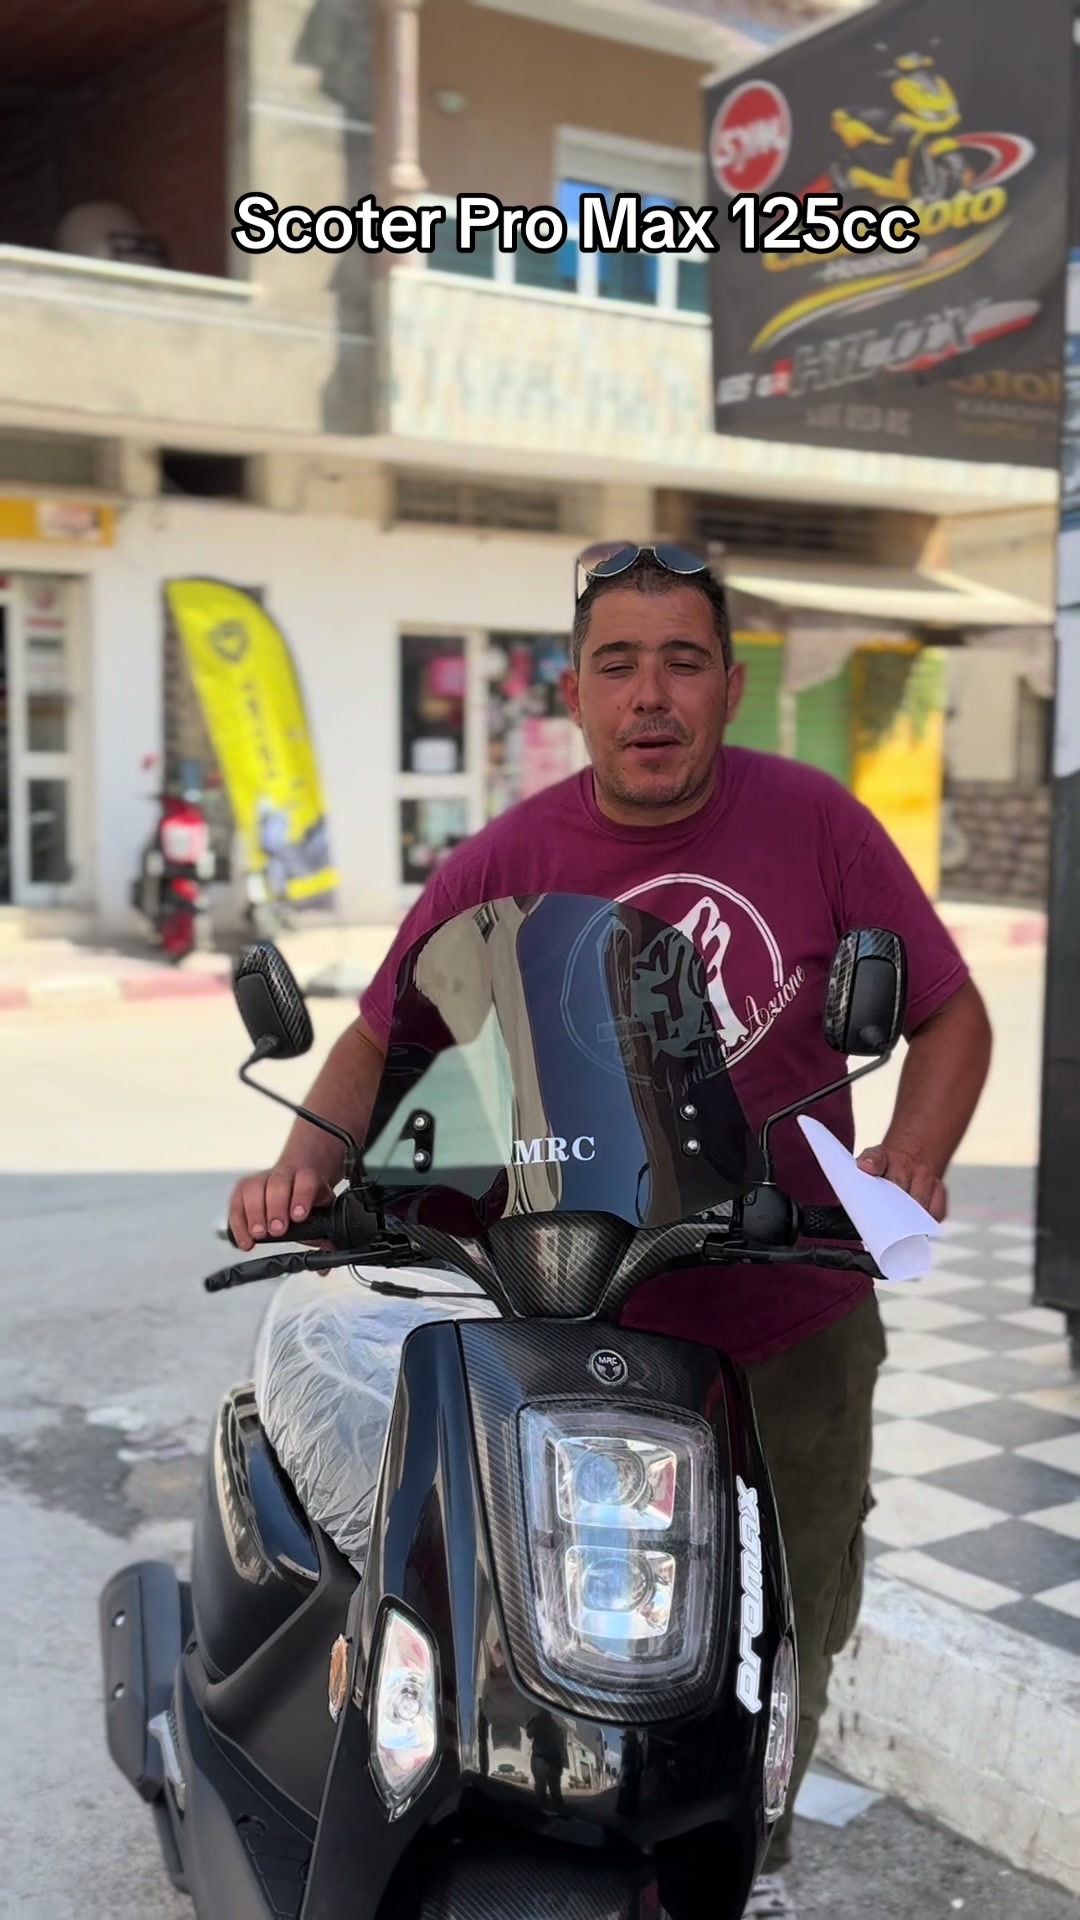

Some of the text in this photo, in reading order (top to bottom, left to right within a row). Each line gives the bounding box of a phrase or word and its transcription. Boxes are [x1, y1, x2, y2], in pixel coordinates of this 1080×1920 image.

[740, 965, 805, 1042] Azione
[513, 1136, 596, 1165] MRC
[598, 1355, 618, 1367] MRC
[736, 1475, 763, 1714] promax
